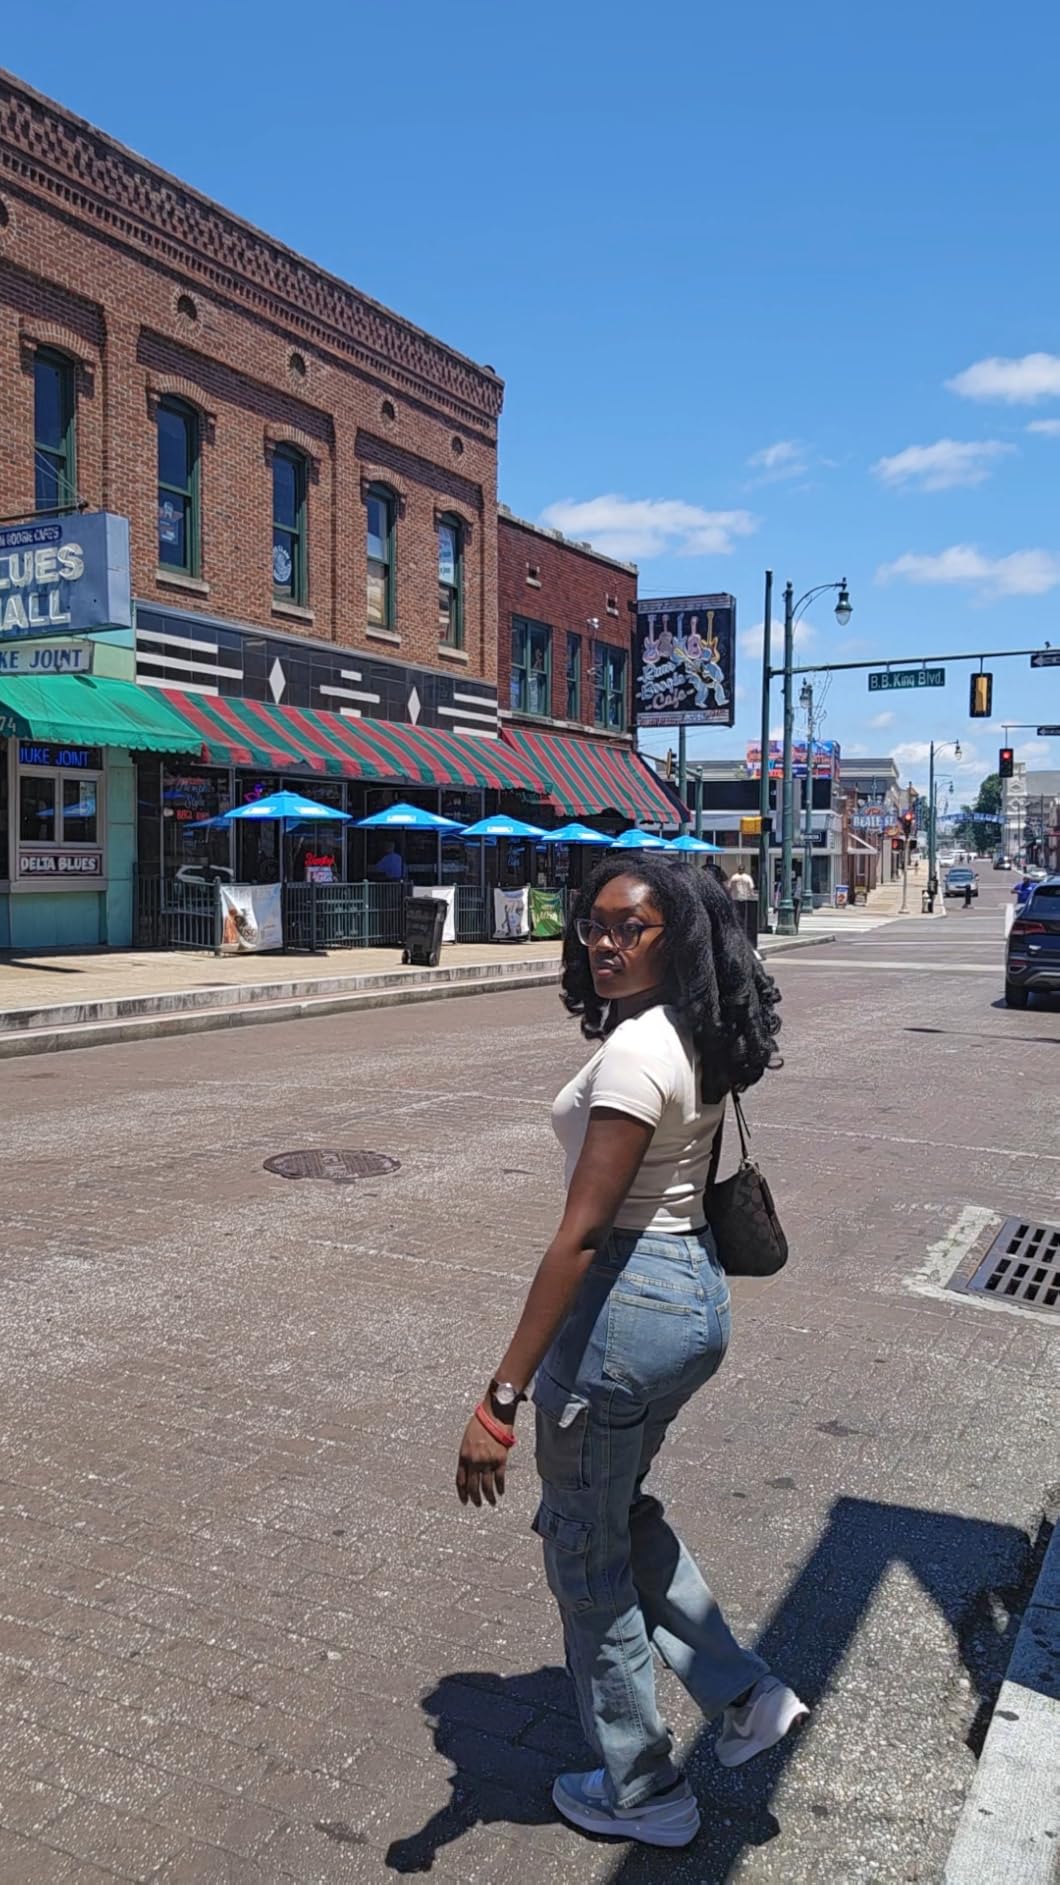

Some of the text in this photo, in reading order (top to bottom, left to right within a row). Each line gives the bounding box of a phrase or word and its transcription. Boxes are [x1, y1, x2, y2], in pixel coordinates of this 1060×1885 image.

[0, 590, 71, 631] ALL
[29, 648, 83, 668] JOINT
[918, 671, 944, 686] Blvd.
[55, 750, 88, 767] JOINT
[21, 857, 97, 871] DELTA BLUES
